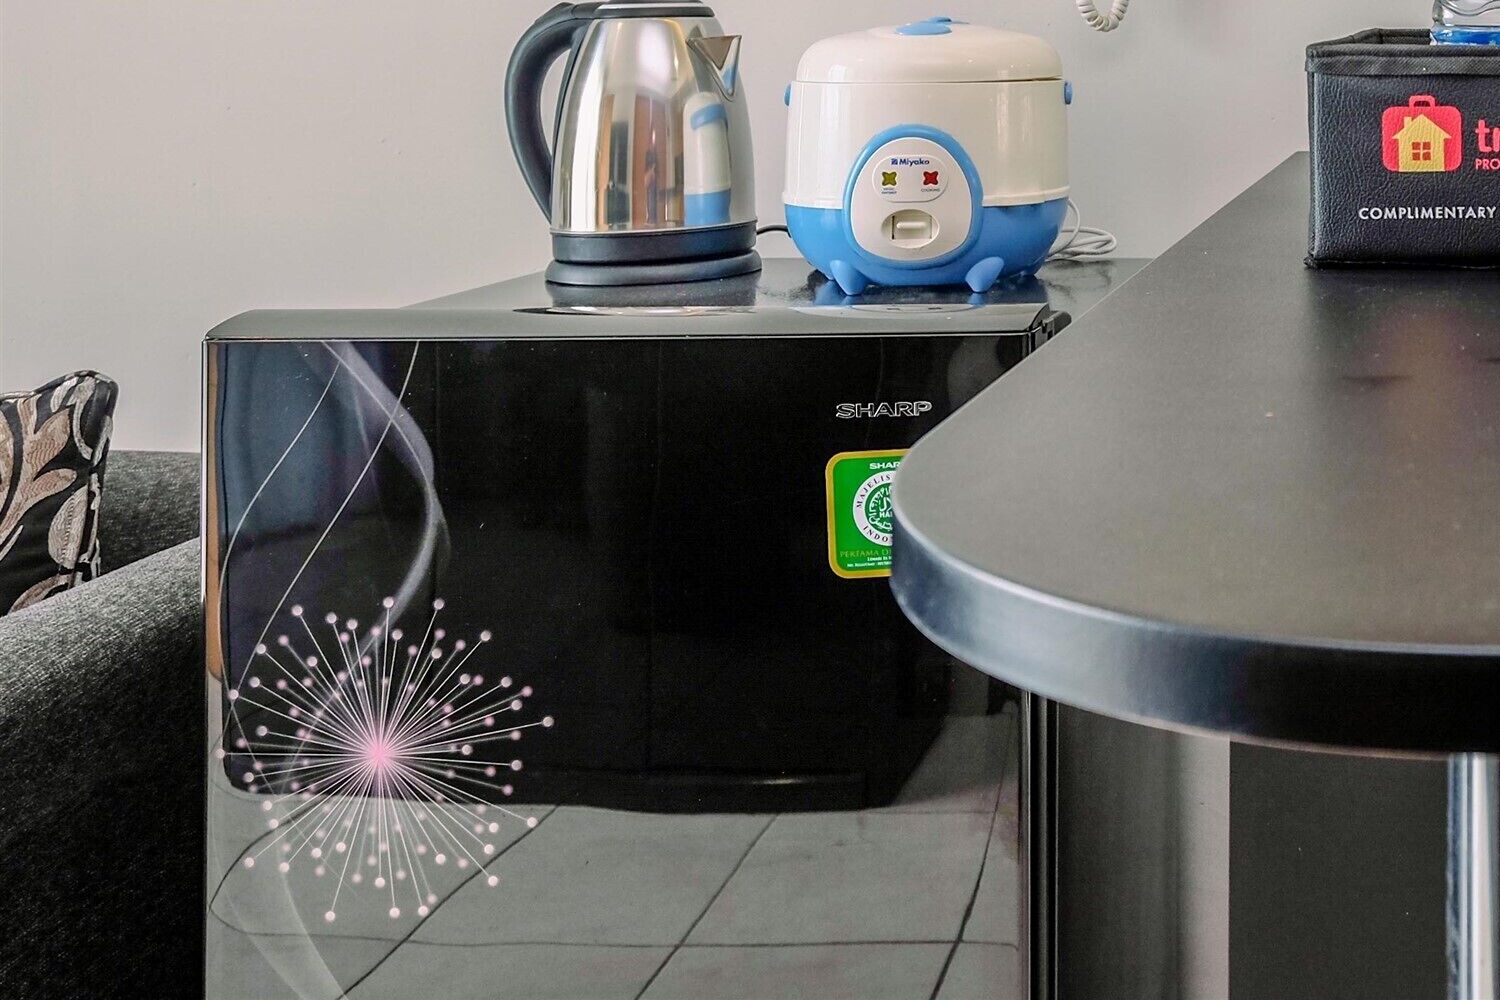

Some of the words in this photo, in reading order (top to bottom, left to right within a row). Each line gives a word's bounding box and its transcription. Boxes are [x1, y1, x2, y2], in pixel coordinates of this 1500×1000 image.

[899, 158, 930, 167] Miyako
[1358, 206, 1497, 220] COMPLIMENTARY
[836, 401, 933, 419] SHARP
[869, 462, 900, 470] SHAR
[863, 525, 889, 543] INDO
